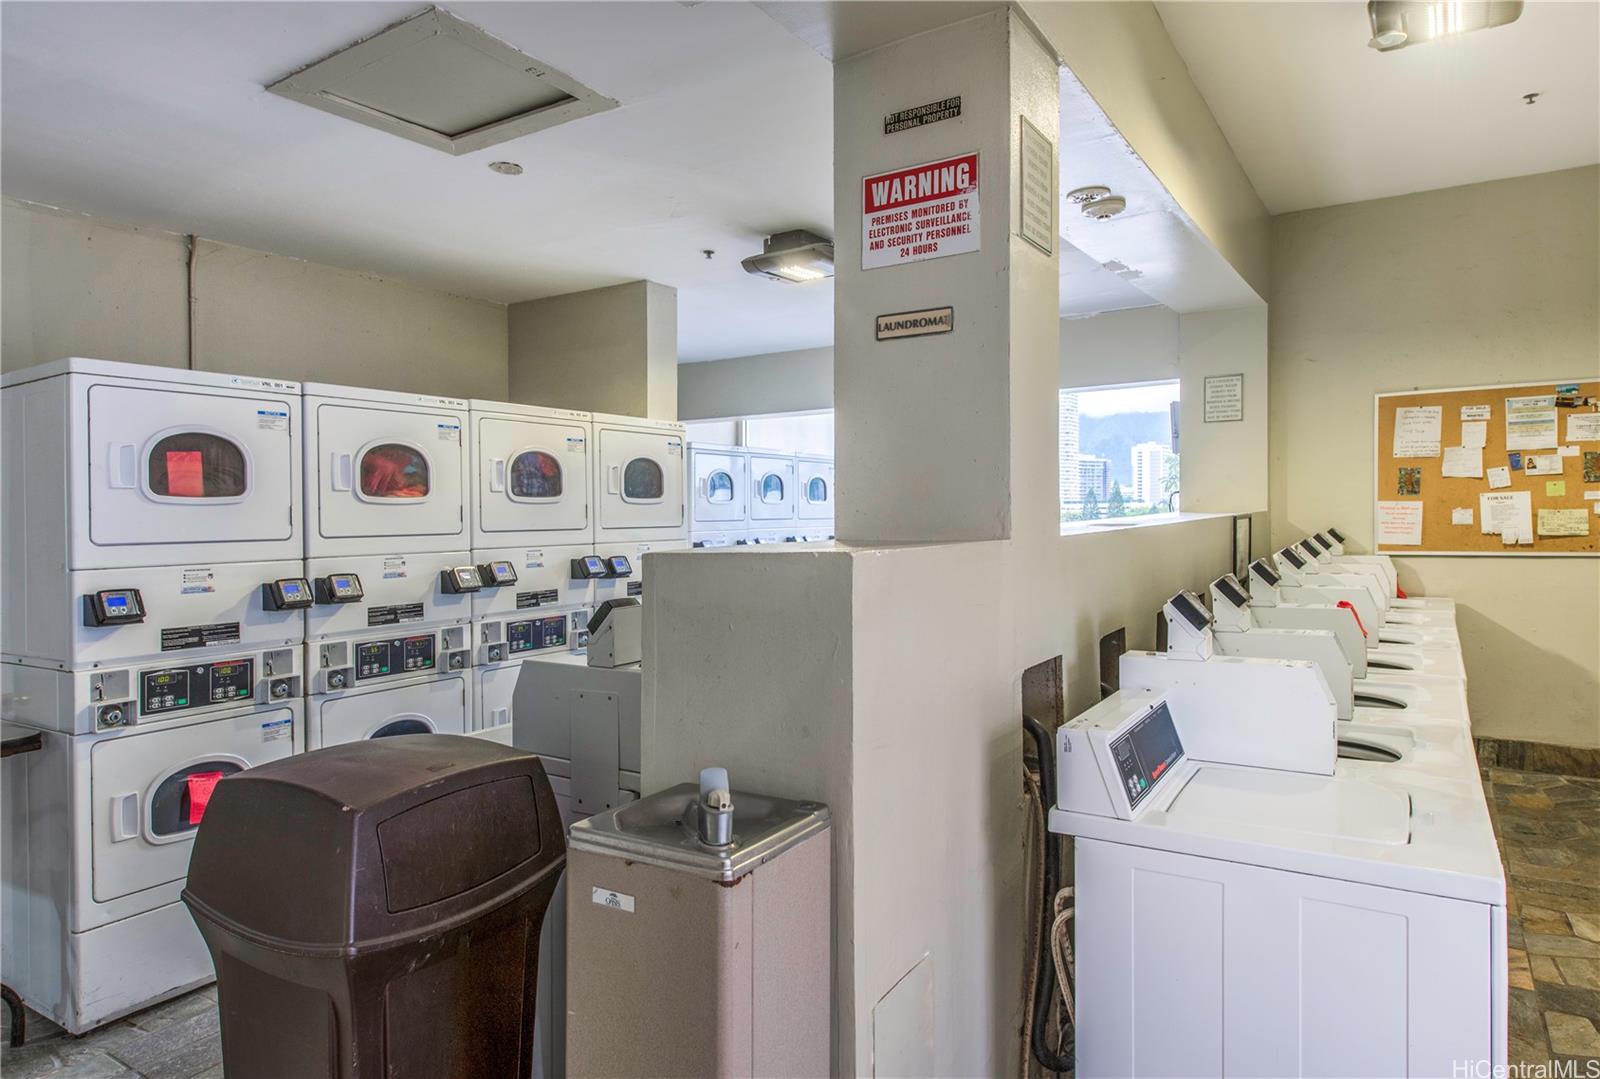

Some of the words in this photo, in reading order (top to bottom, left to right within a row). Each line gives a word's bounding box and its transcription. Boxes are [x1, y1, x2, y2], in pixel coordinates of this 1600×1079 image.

[886, 118, 921, 133] PERSONAL
[922, 106, 959, 124] PROPERTY
[900, 102, 945, 119] RESPONSIBLE
[946, 97, 961, 109] FOR
[872, 162, 969, 207] WARNING
[869, 223, 913, 239] ELECTRONIC
[915, 211, 972, 231] SURVEILLANCE
[872, 211, 908, 226] PREMISES
[911, 202, 955, 219] MONITORED
[958, 199, 969, 210] BY
[869, 241, 885, 251] AND
[887, 232, 923, 248] SECURITY
[926, 223, 972, 241] PERSONNEL
[900, 248, 910, 258] 24
[912, 242, 939, 256] HOURS
